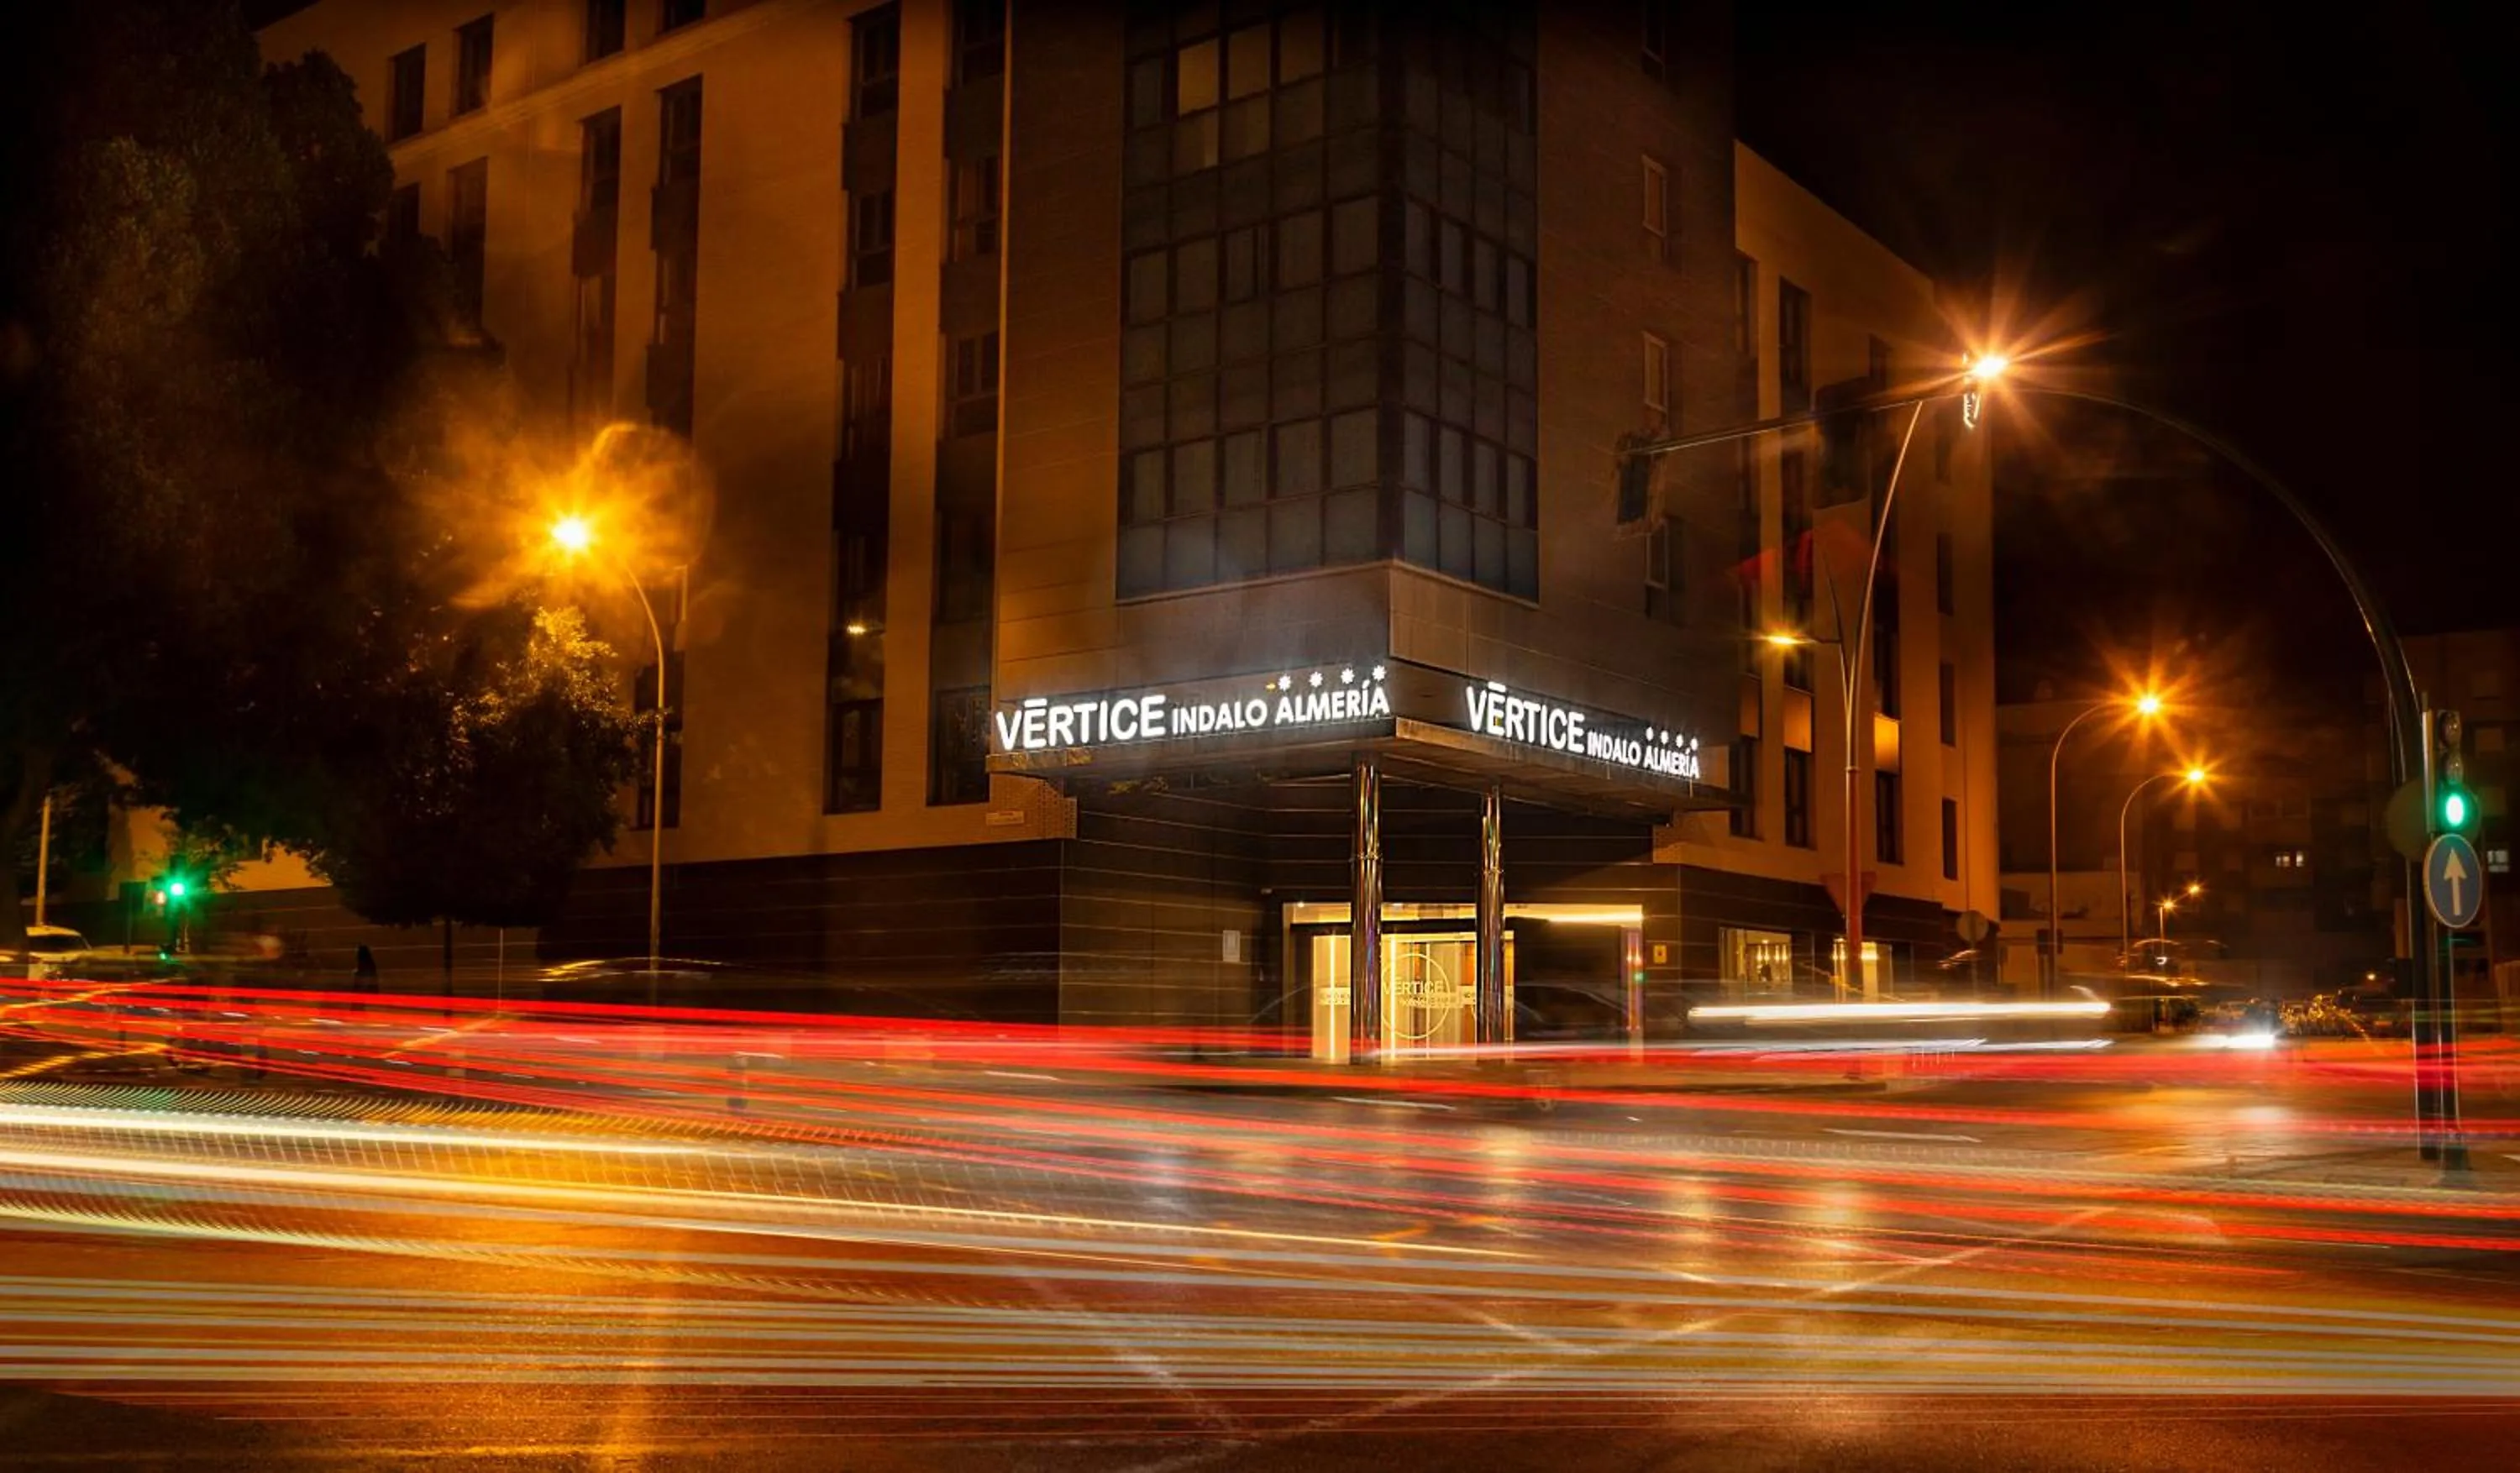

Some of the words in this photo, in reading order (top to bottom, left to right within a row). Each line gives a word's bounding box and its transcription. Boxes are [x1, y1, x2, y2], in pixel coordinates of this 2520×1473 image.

[1172, 698, 1268, 736] INDALO
[1273, 679, 1391, 726] ALMERÍA
[1587, 730, 1642, 767] INDALO
[1642, 747, 1701, 780] ALMERÍA
